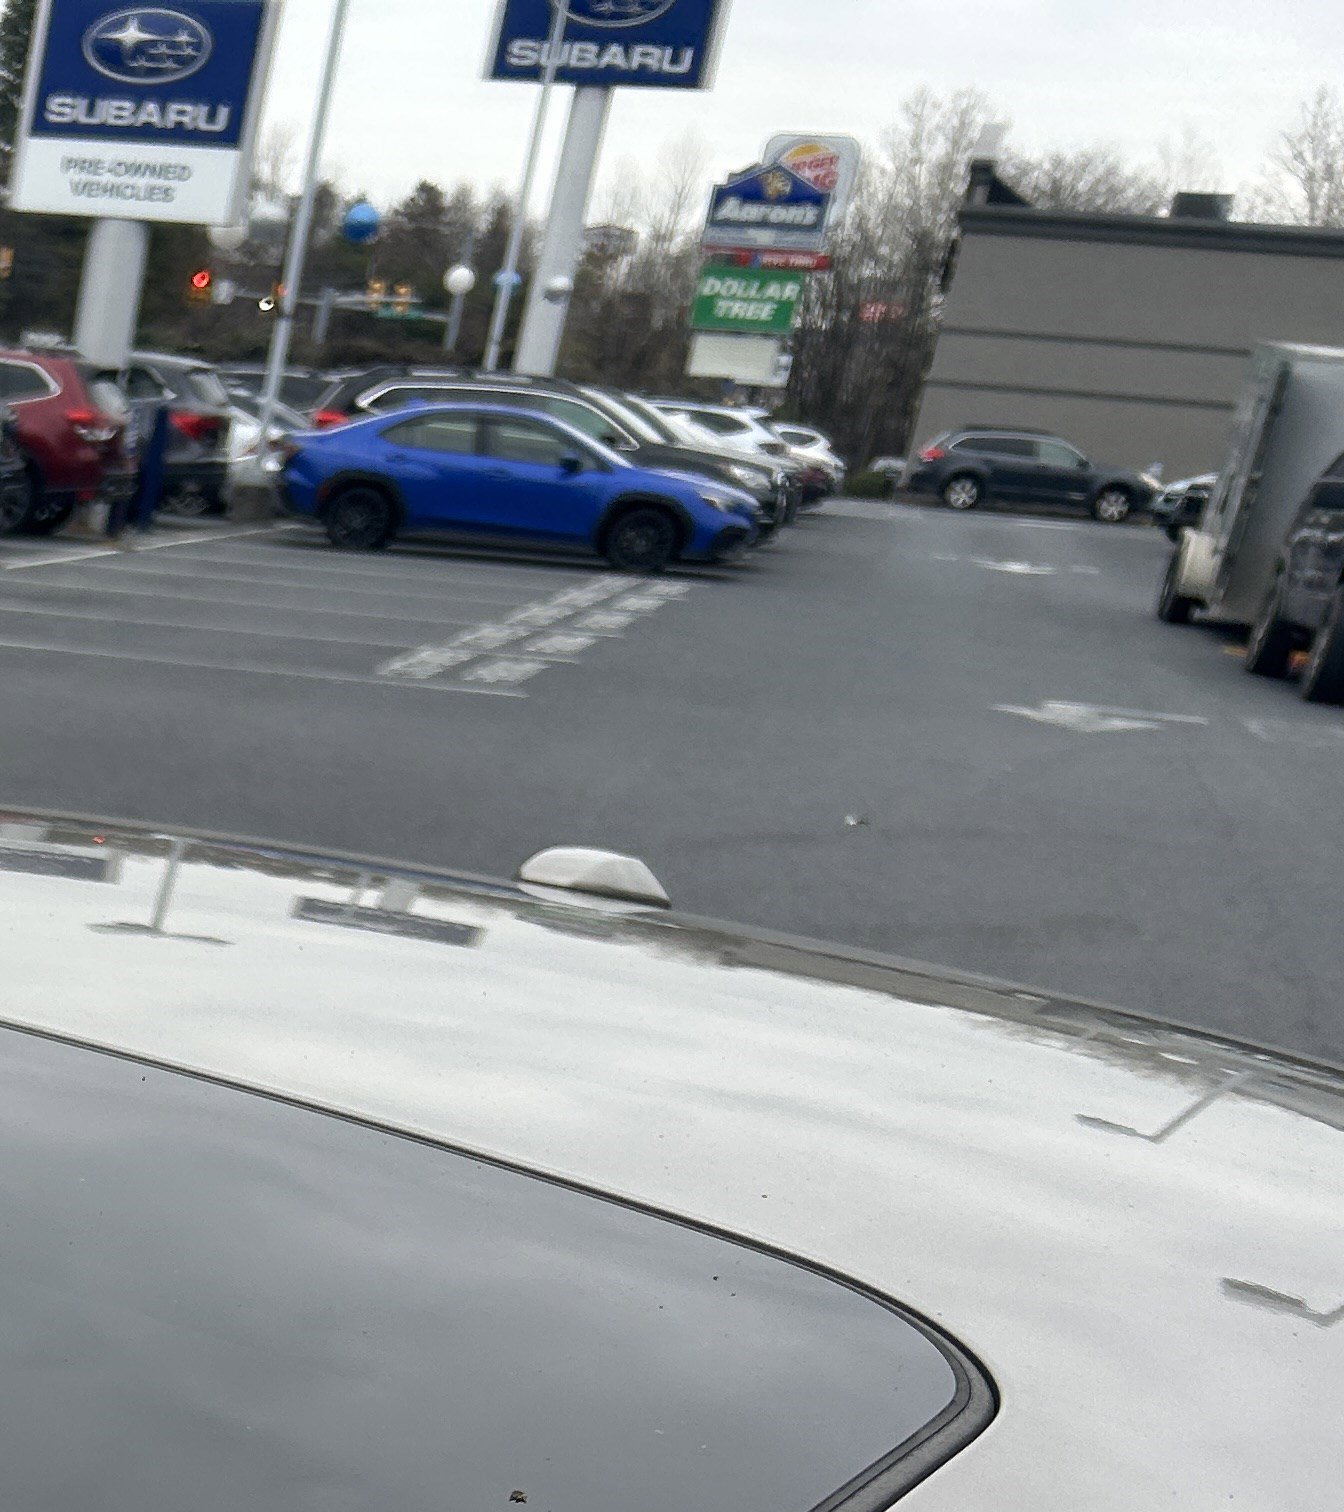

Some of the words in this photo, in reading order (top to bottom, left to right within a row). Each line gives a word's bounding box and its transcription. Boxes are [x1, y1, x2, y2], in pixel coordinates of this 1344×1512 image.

[505, 38, 695, 74] SUBARU
[43, 95, 231, 132] SUBARU
[62, 158, 192, 182] PRE-OWNED
[69, 180, 176, 202] VEHICLES
[702, 276, 801, 301] DOLLAR
[714, 299, 779, 321] TREE
